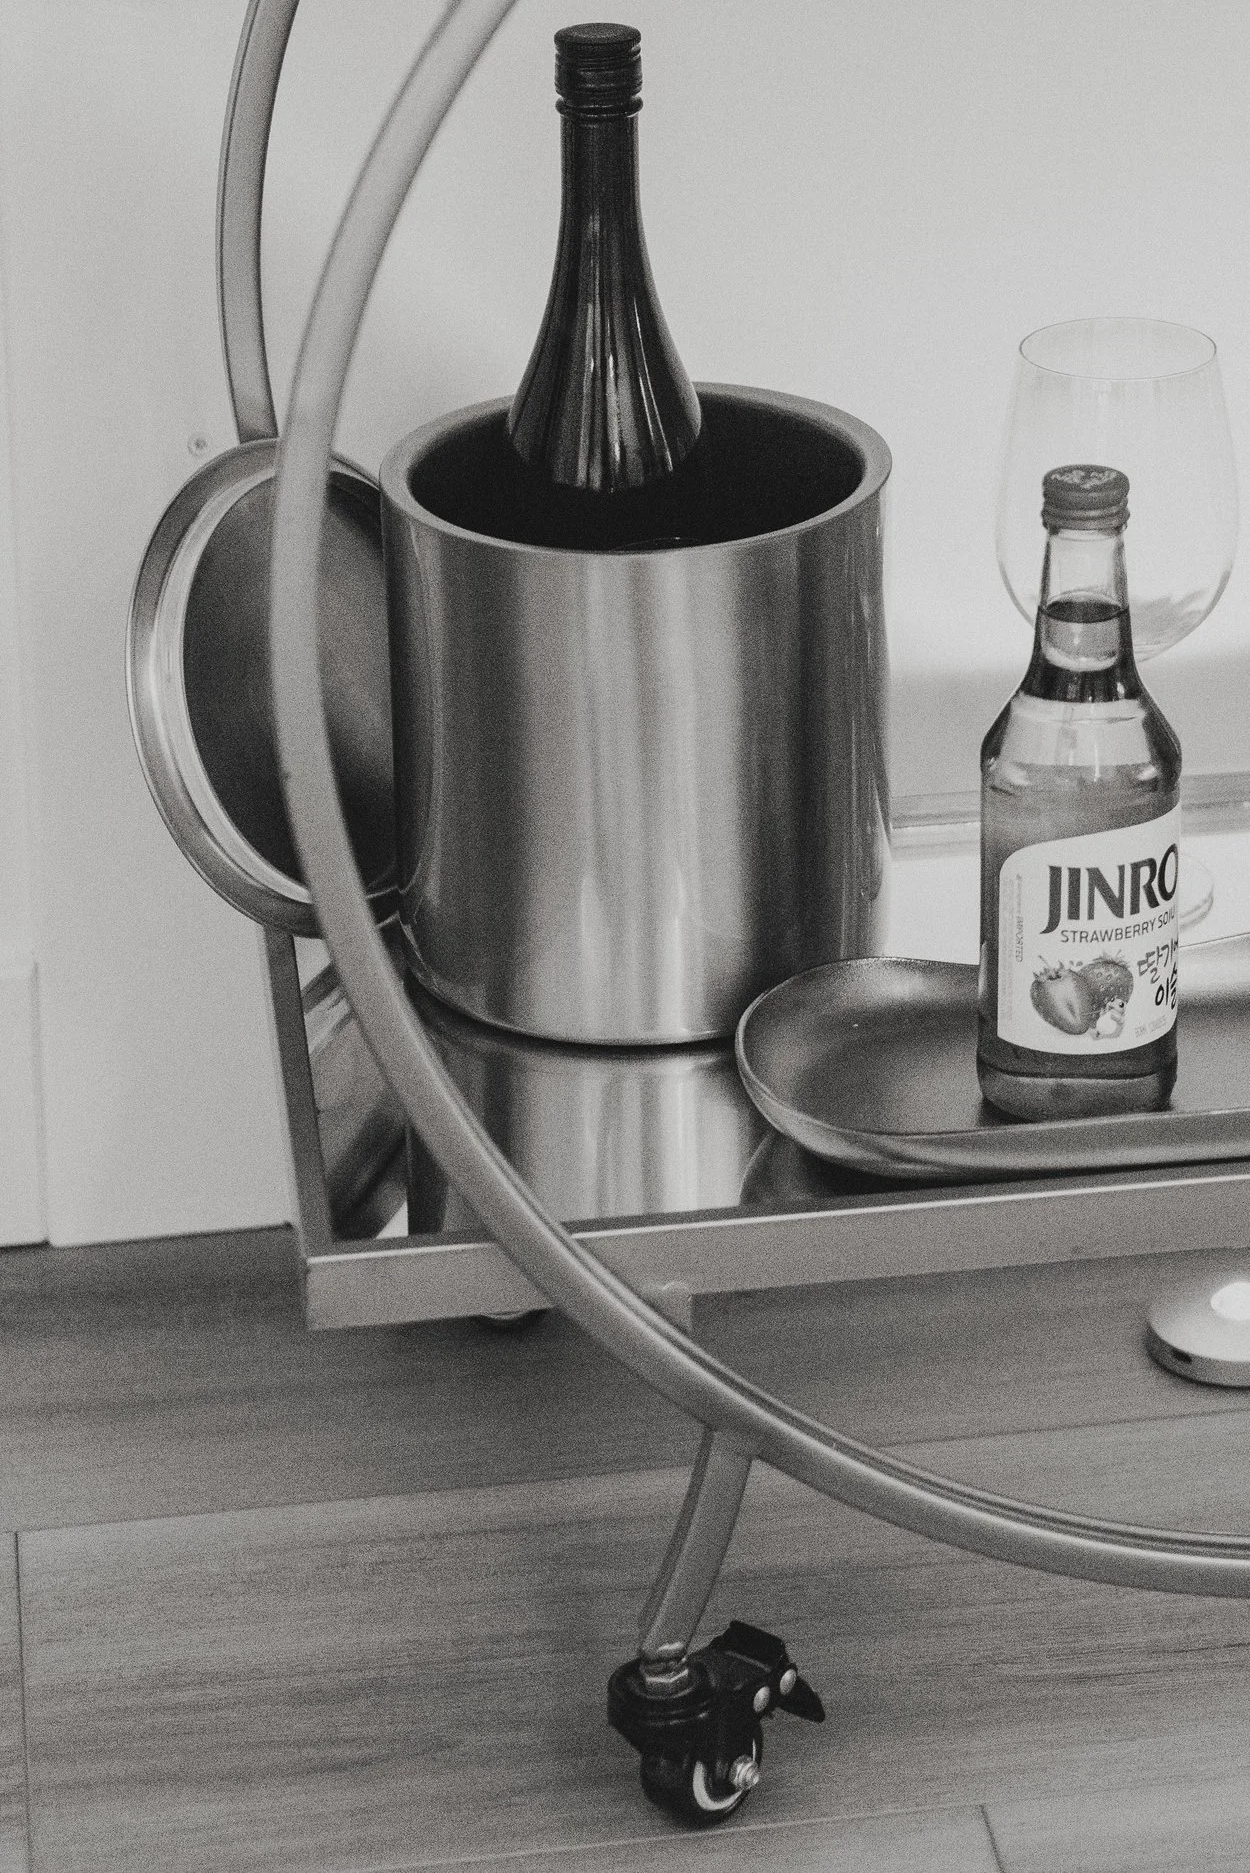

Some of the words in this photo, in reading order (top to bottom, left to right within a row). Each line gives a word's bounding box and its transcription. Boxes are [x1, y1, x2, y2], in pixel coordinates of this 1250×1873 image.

[1039, 843, 1179, 935] JINRO
[1015, 916, 1024, 963] IMPORTED
[1060, 917, 1157, 944] STRAWBERRY
